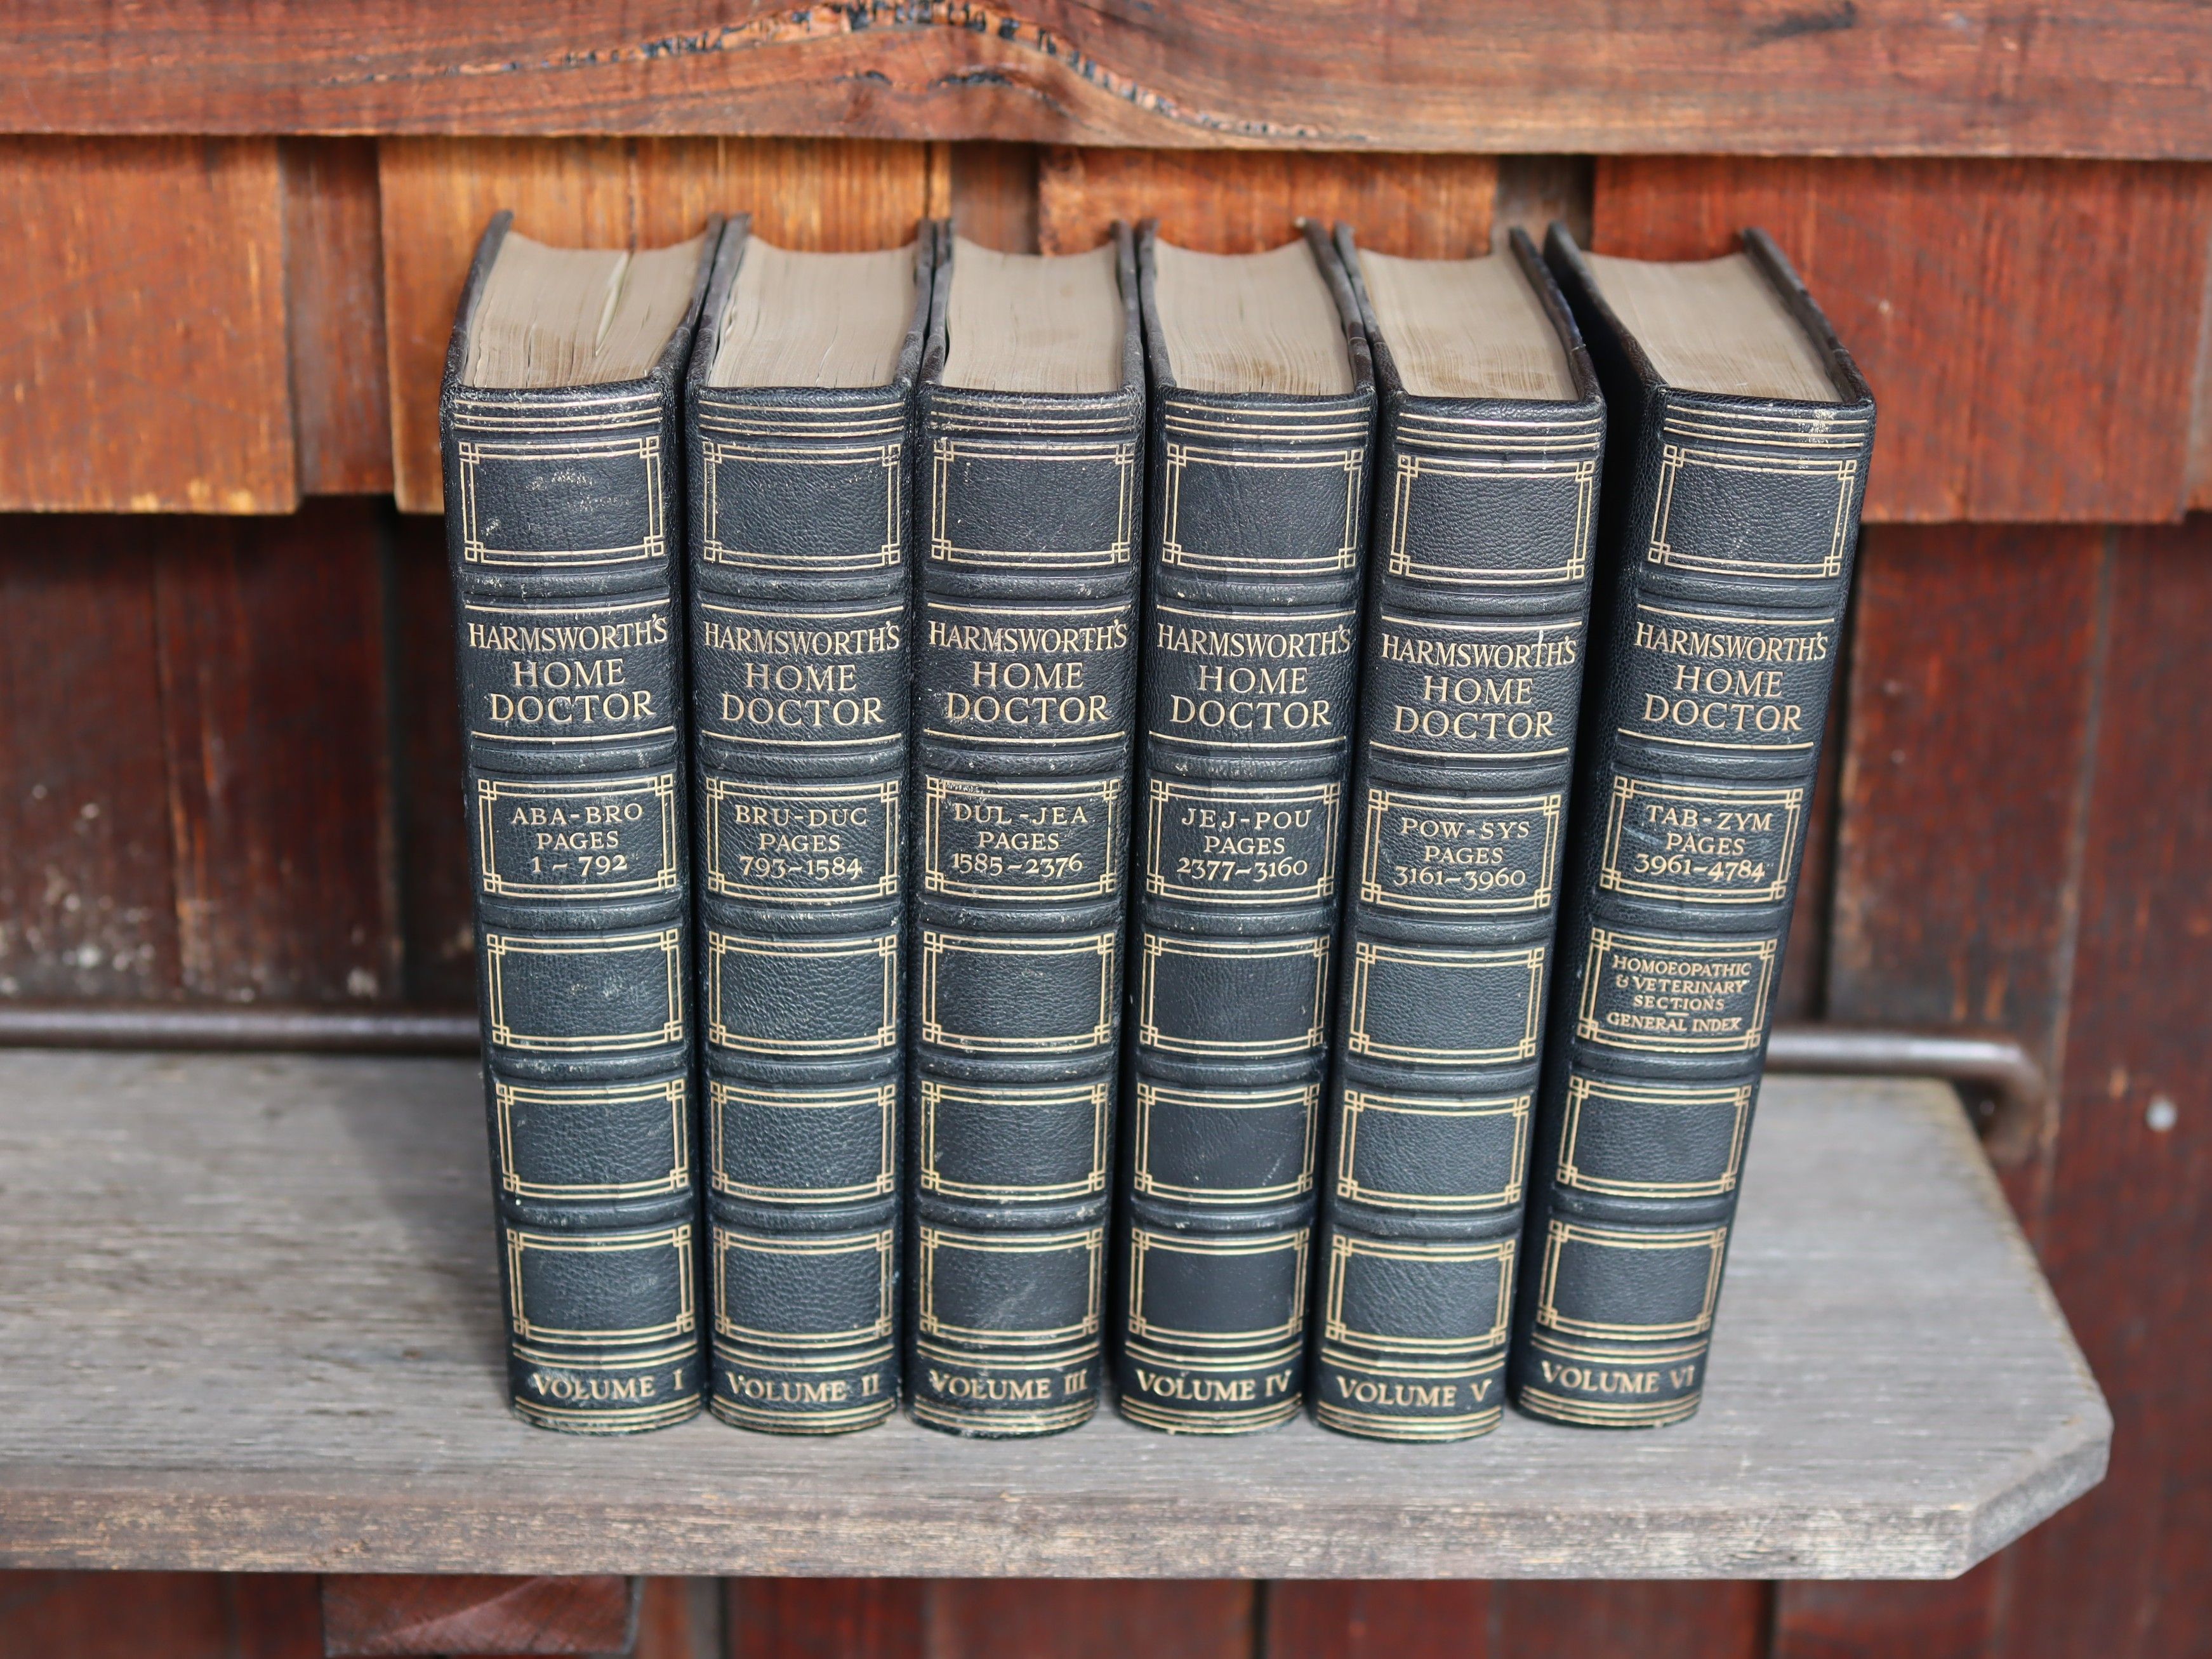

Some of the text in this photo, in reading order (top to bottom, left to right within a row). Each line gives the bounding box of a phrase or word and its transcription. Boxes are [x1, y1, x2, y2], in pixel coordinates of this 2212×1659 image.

[468, 613, 668, 652] HARMSWORTH'S
[703, 620, 901, 655] HARMSWORTH'S
[927, 619, 1127, 653] HARMSWORTH'S
[1157, 623, 1353, 658] HARMSWORTH'S
[1633, 621, 1828, 662] HARMSWORTH'S
[1381, 633, 1577, 668] HARMSWORTH'S
[512, 658, 626, 687] HOME
[745, 663, 858, 692] HOME
[972, 661, 1084, 689] HOME
[1197, 664, 1308, 694] HOME
[1673, 664, 1785, 697] HOME
[1423, 675, 1533, 704] HOME
[489, 690, 656, 723] DOCTOR
[720, 692, 884, 727] DOCTOR
[945, 692, 1110, 724] DOCTOR
[1169, 694, 1332, 730] DOCTOR
[1393, 704, 1556, 739] DOCTOR
[1641, 692, 1803, 731] DOCTOR
[512, 803, 643, 826] ABA-BRO
[735, 804, 868, 826] BRU-DUC
[1181, 807, 1312, 830] JEJ-POU
[1400, 817, 1530, 840] POW-SYS
[1645, 804, 1773, 831] TAB-ZYM
[536, 830, 619, 850] PAGES
[758, 832, 841, 852] PAGES
[977, 831, 1060, 850] PAGES
[1203, 835, 1286, 855] PAGES
[1424, 845, 1504, 864] PAGES
[1666, 831, 1745, 856] PAGES
[1612, 955, 1752, 977] HOMOEOPATHIC
[1615, 974, 1750, 994] & VETERINARY
[1633, 995, 1725, 1011] SECTIONS
[1606, 1012, 1742, 1032] GENERAL INDEX
[533, 1369, 684, 1400] VOLUME I
[727, 1371, 880, 1403] VOLUME II
[930, 1369, 1089, 1400] VOLUME III
[1136, 1369, 1294, 1402] VOLUME IV
[1337, 1376, 1492, 1407] VOLUME V
[1542, 1361, 1695, 1393] VOLUME VI
